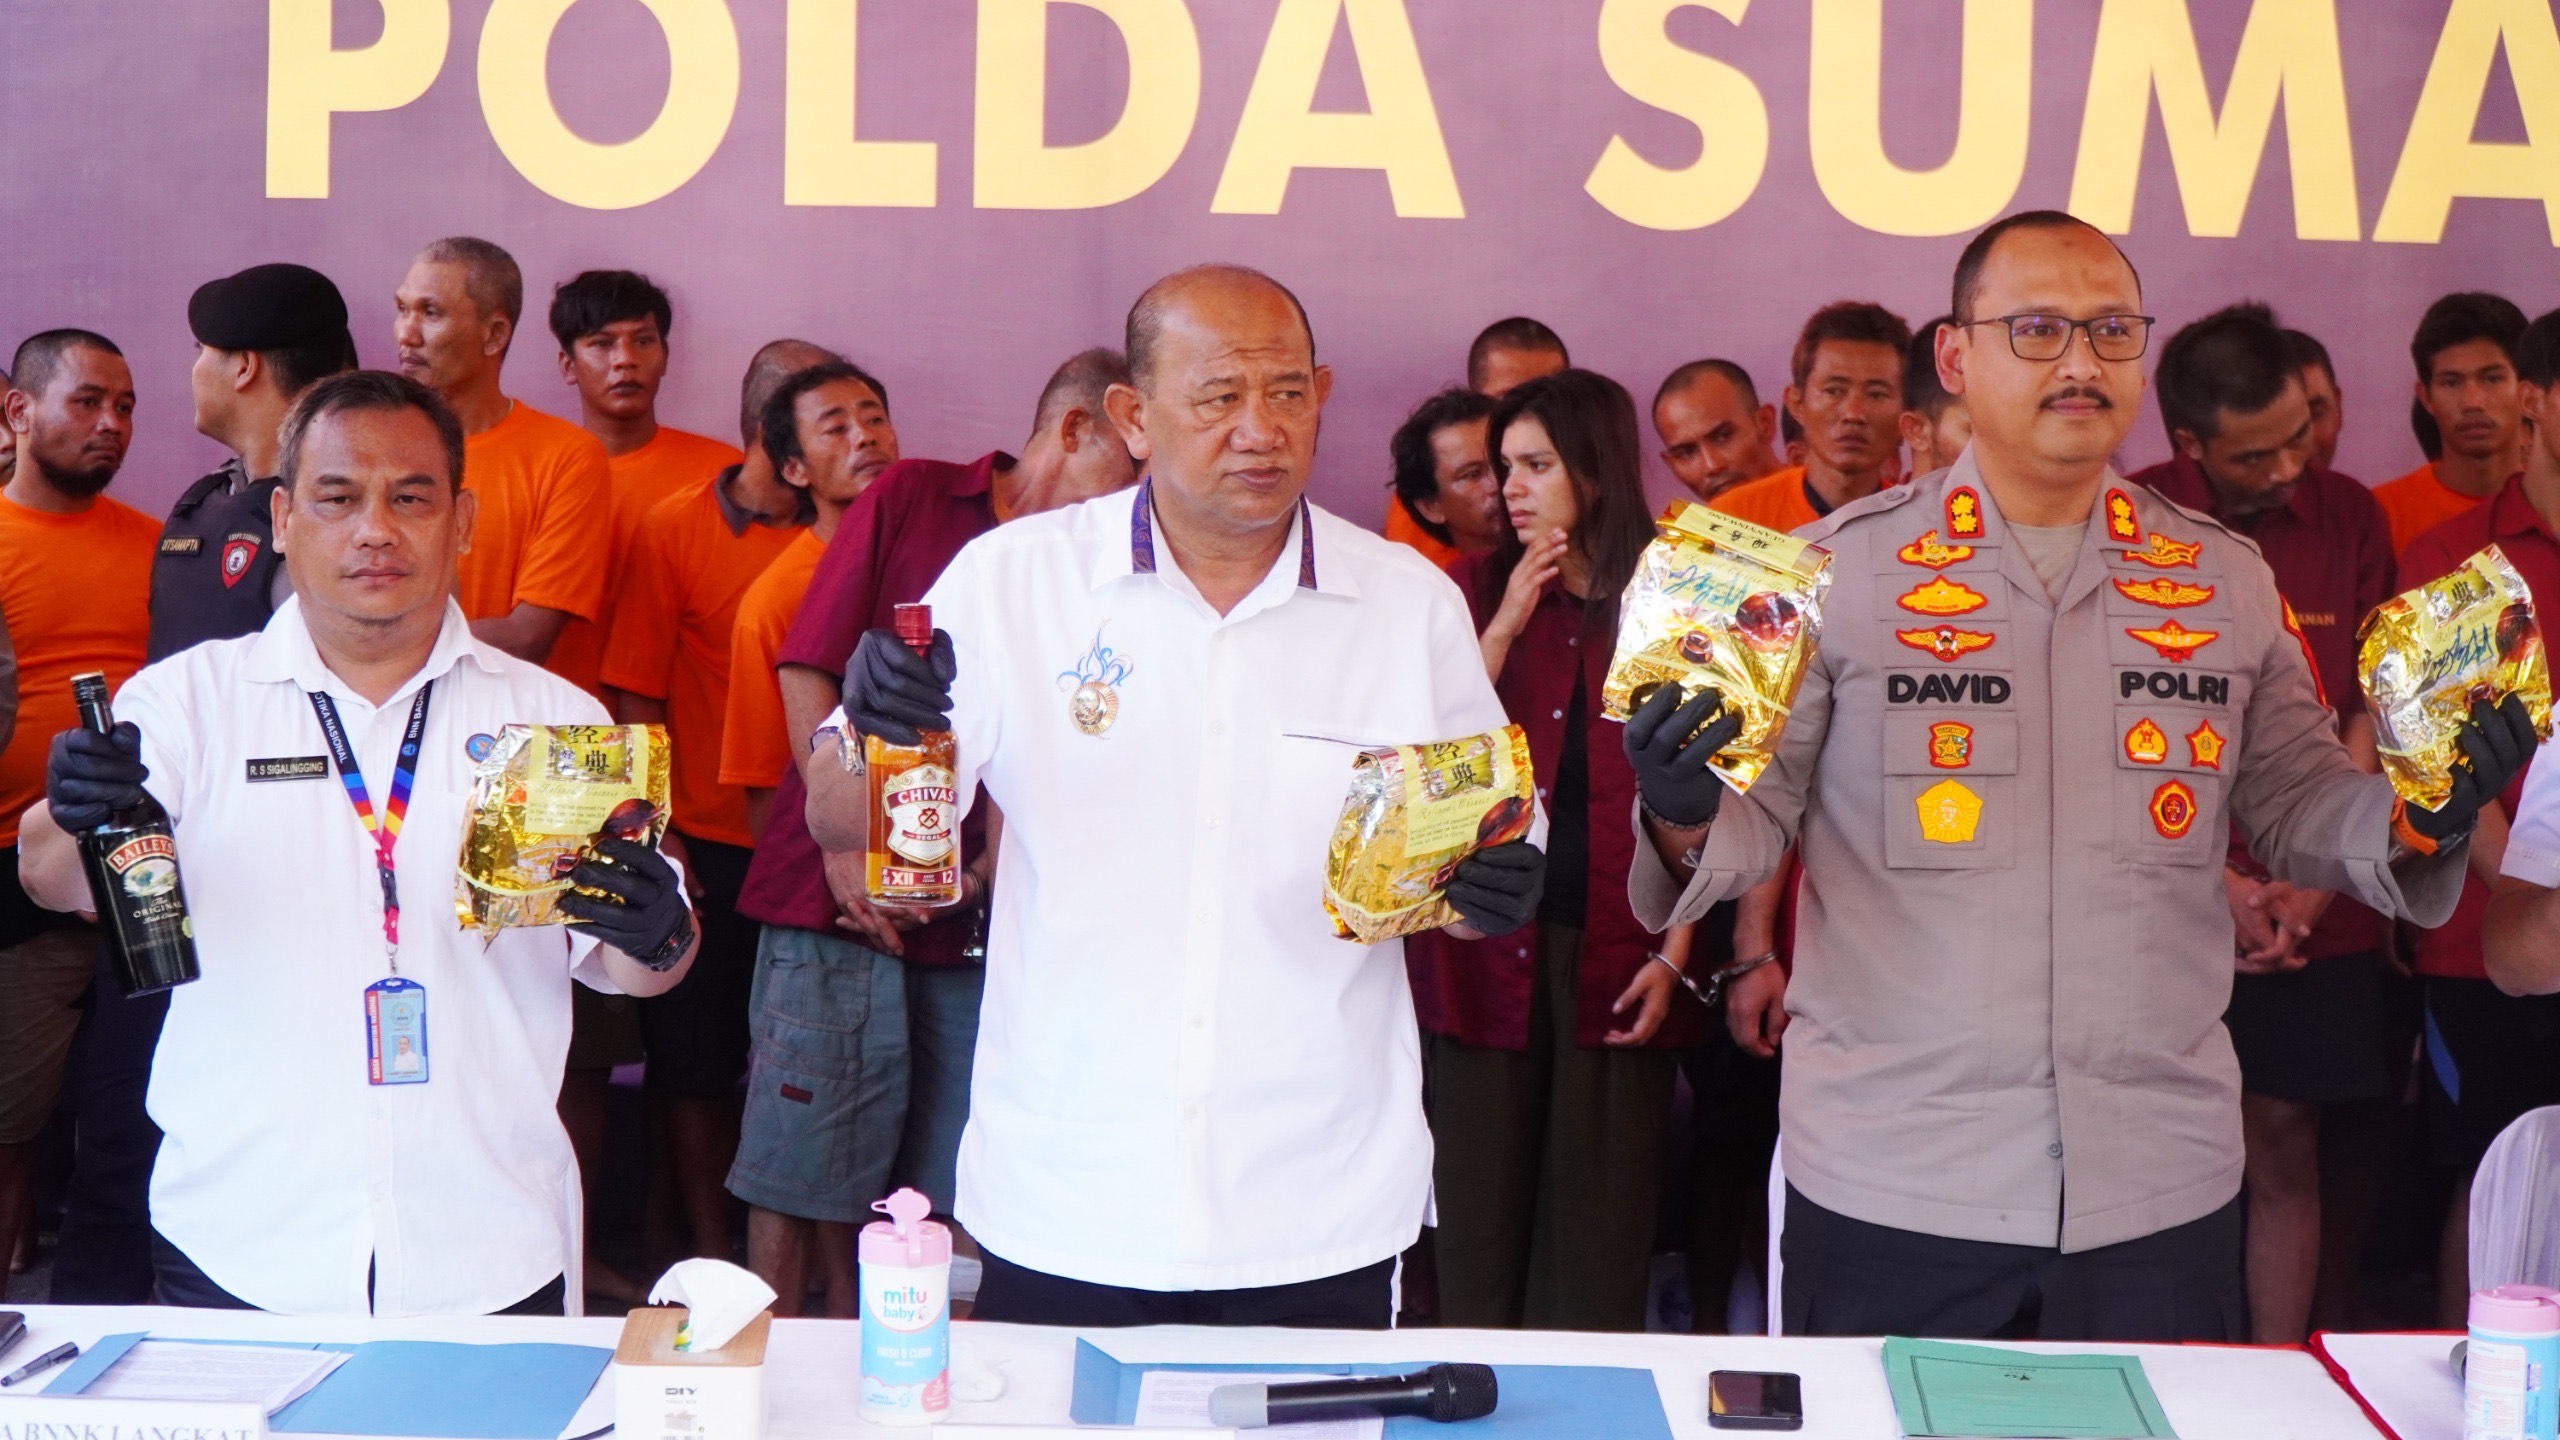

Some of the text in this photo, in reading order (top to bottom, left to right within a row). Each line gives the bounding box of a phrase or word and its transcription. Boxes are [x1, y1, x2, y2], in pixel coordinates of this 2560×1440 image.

[265, 0, 2560, 247] POLDA SUMA
[161, 538, 199, 551] DITSAMAPTA
[1887, 674, 2011, 704] DAVID
[2120, 671, 2229, 705] POLRI
[408, 722, 421, 739] BNN
[324, 719, 349, 764] NASIONAL
[249, 761, 325, 776] R. S SIGALINGGING
[897, 788, 954, 803] CHIVAS
[112, 838, 173, 868] BAILEYS
[891, 872, 914, 886] XII
[942, 870, 954, 884] 12
[133, 901, 183, 918] ORIGINAL
[884, 1286, 927, 1304] mitu
[884, 1306, 915, 1321] baby
[665, 1387, 698, 1395] DIY
[25, 1423, 103, 1440] BNNK
